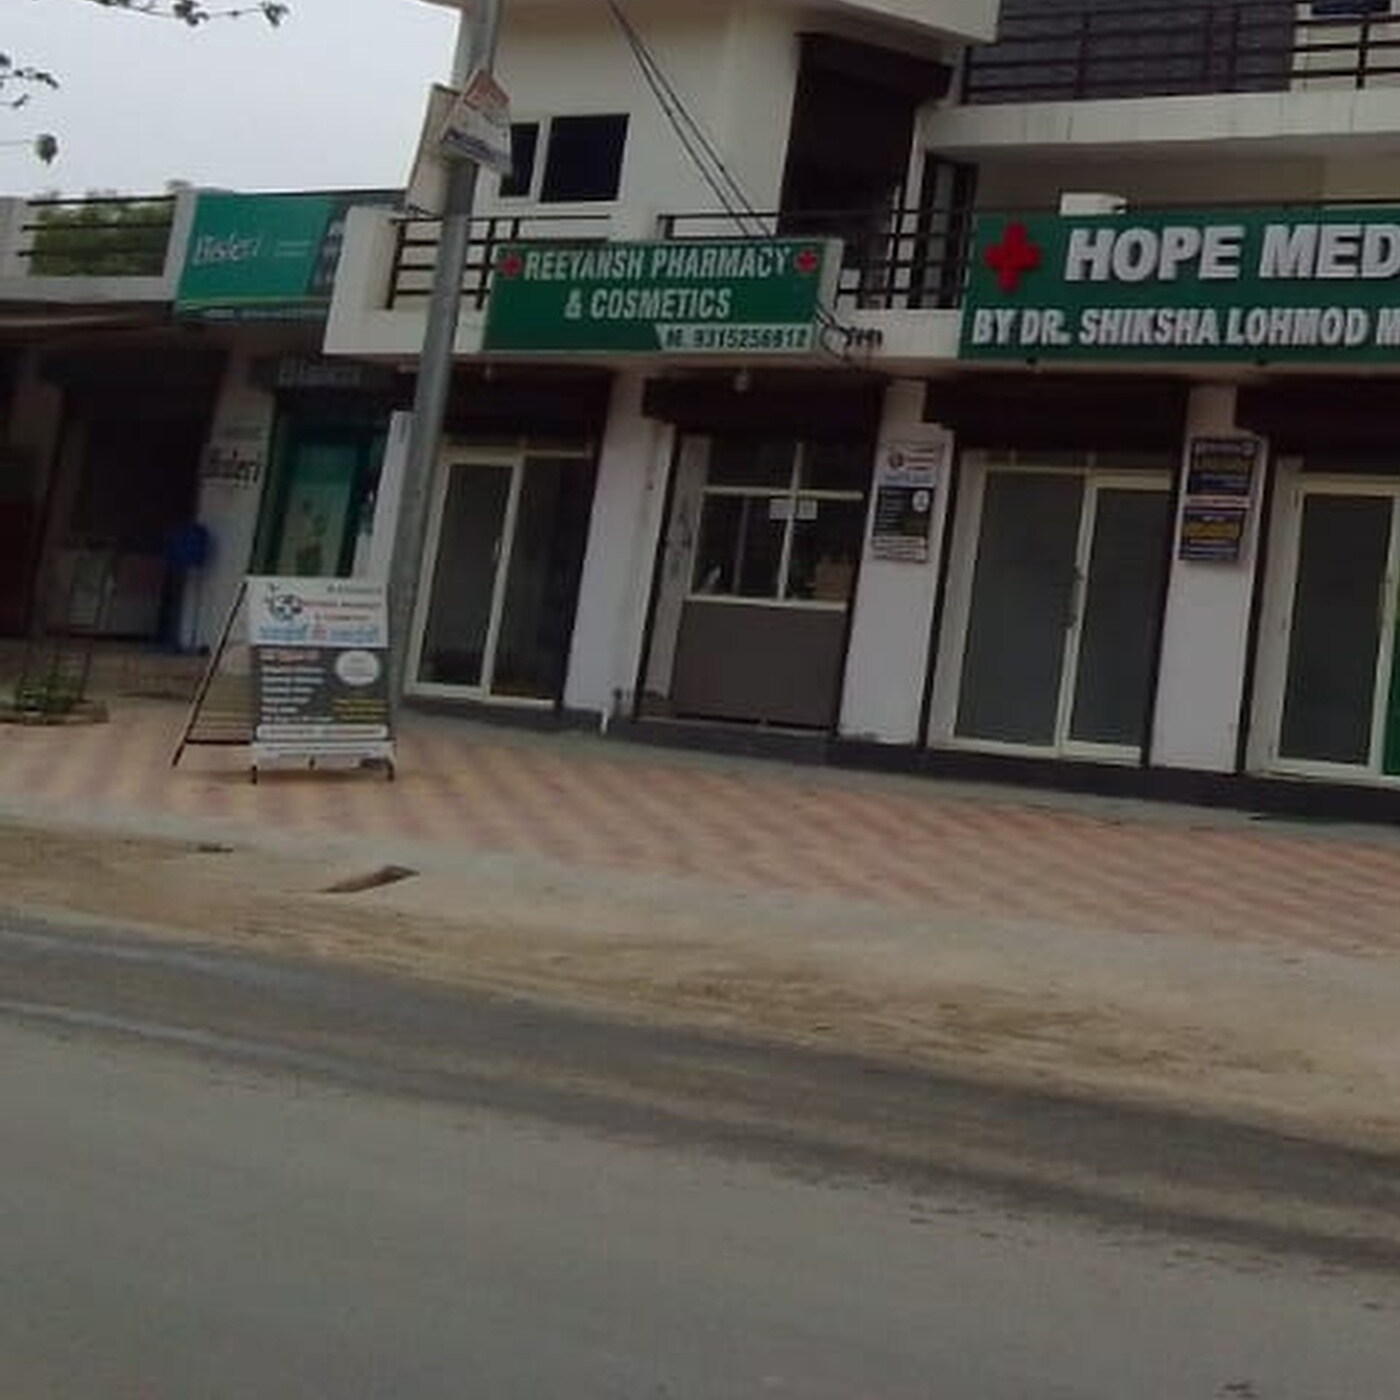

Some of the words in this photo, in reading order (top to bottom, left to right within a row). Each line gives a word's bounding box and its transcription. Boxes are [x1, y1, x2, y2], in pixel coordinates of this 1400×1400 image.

[524, 248, 646, 281] REEYANSH
[651, 246, 792, 280] PHARMACY
[1065, 225, 1244, 282] HOPE
[564, 287, 583, 320] &
[590, 287, 732, 320] COSMETICS
[972, 309, 1018, 345] BY
[1020, 309, 1071, 345] DR.
[1079, 308, 1220, 345] SHIKSHA
[1226, 307, 1369, 345] LOHMOD
